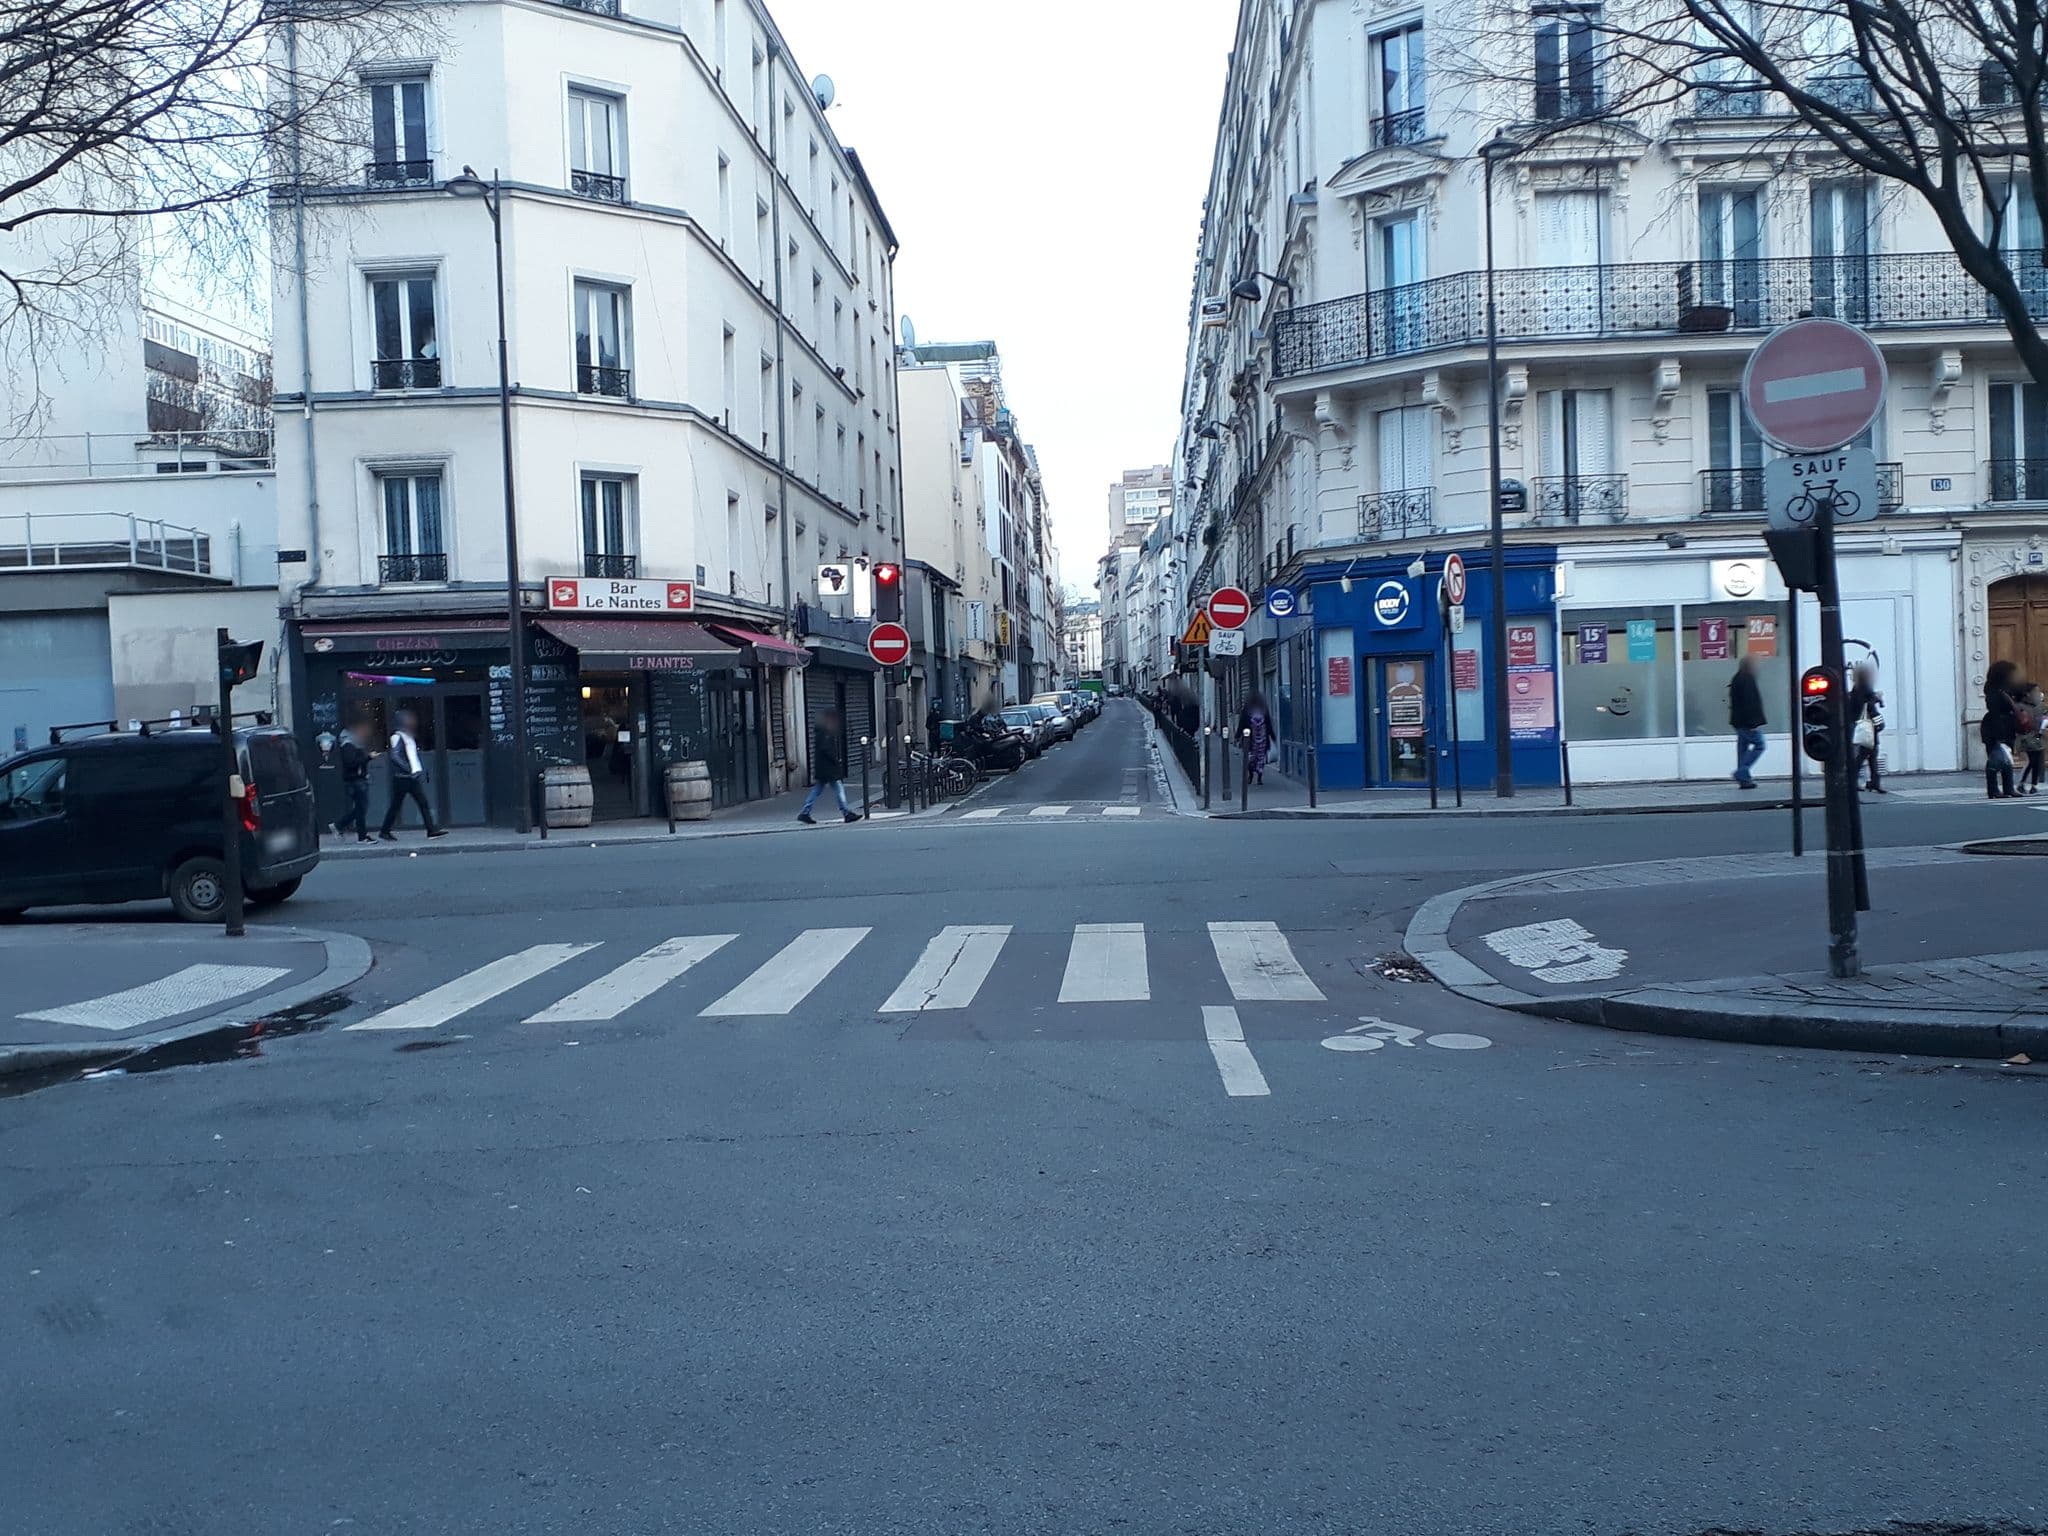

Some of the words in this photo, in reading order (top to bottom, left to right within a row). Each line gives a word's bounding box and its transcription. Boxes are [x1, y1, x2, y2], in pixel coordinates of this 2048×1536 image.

[1792, 457, 1848, 476] SAUF
[1932, 479, 1950, 491] 130
[610, 581, 637, 594] Bar
[586, 596, 603, 608] Le
[609, 596, 661, 609] Nantes
[1218, 631, 1236, 639] SAUF
[629, 657, 643, 669] LE
[647, 657, 694, 670] NANTES
